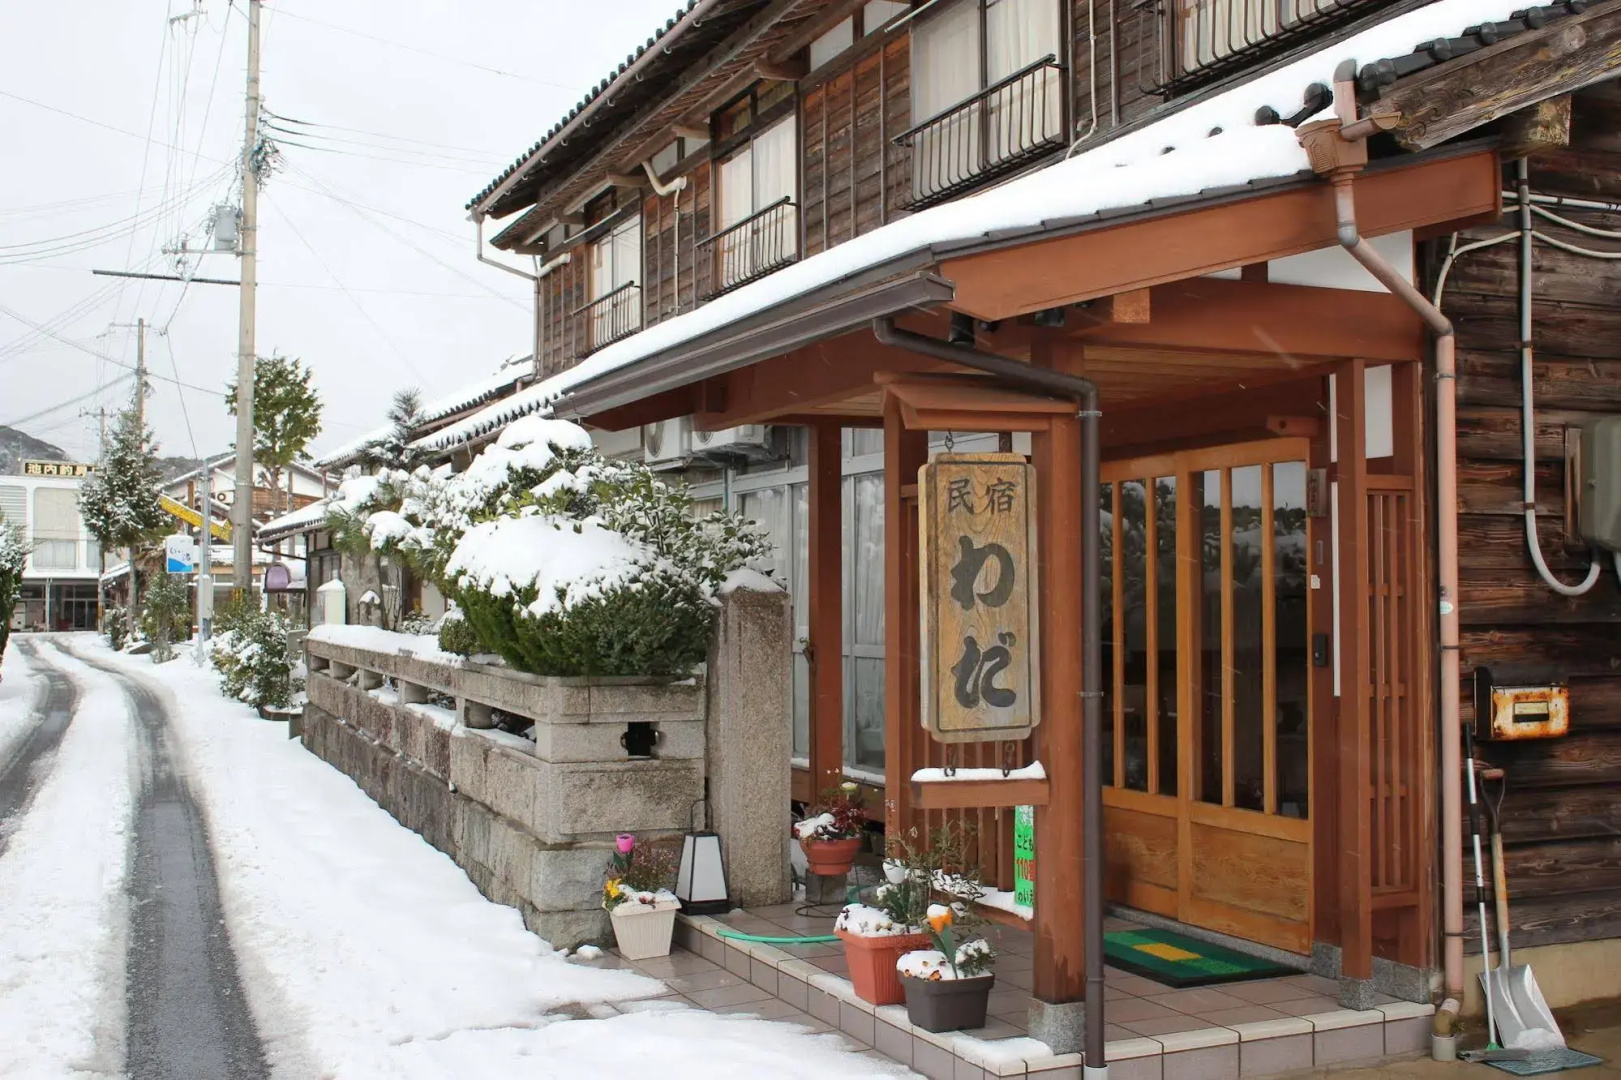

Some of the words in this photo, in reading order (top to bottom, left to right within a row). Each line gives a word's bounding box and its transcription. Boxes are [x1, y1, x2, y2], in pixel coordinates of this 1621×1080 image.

[27, 463, 98, 477] 池内釣具
[946, 477, 1017, 515] 民宿
[950, 535, 1017, 709] わだ
